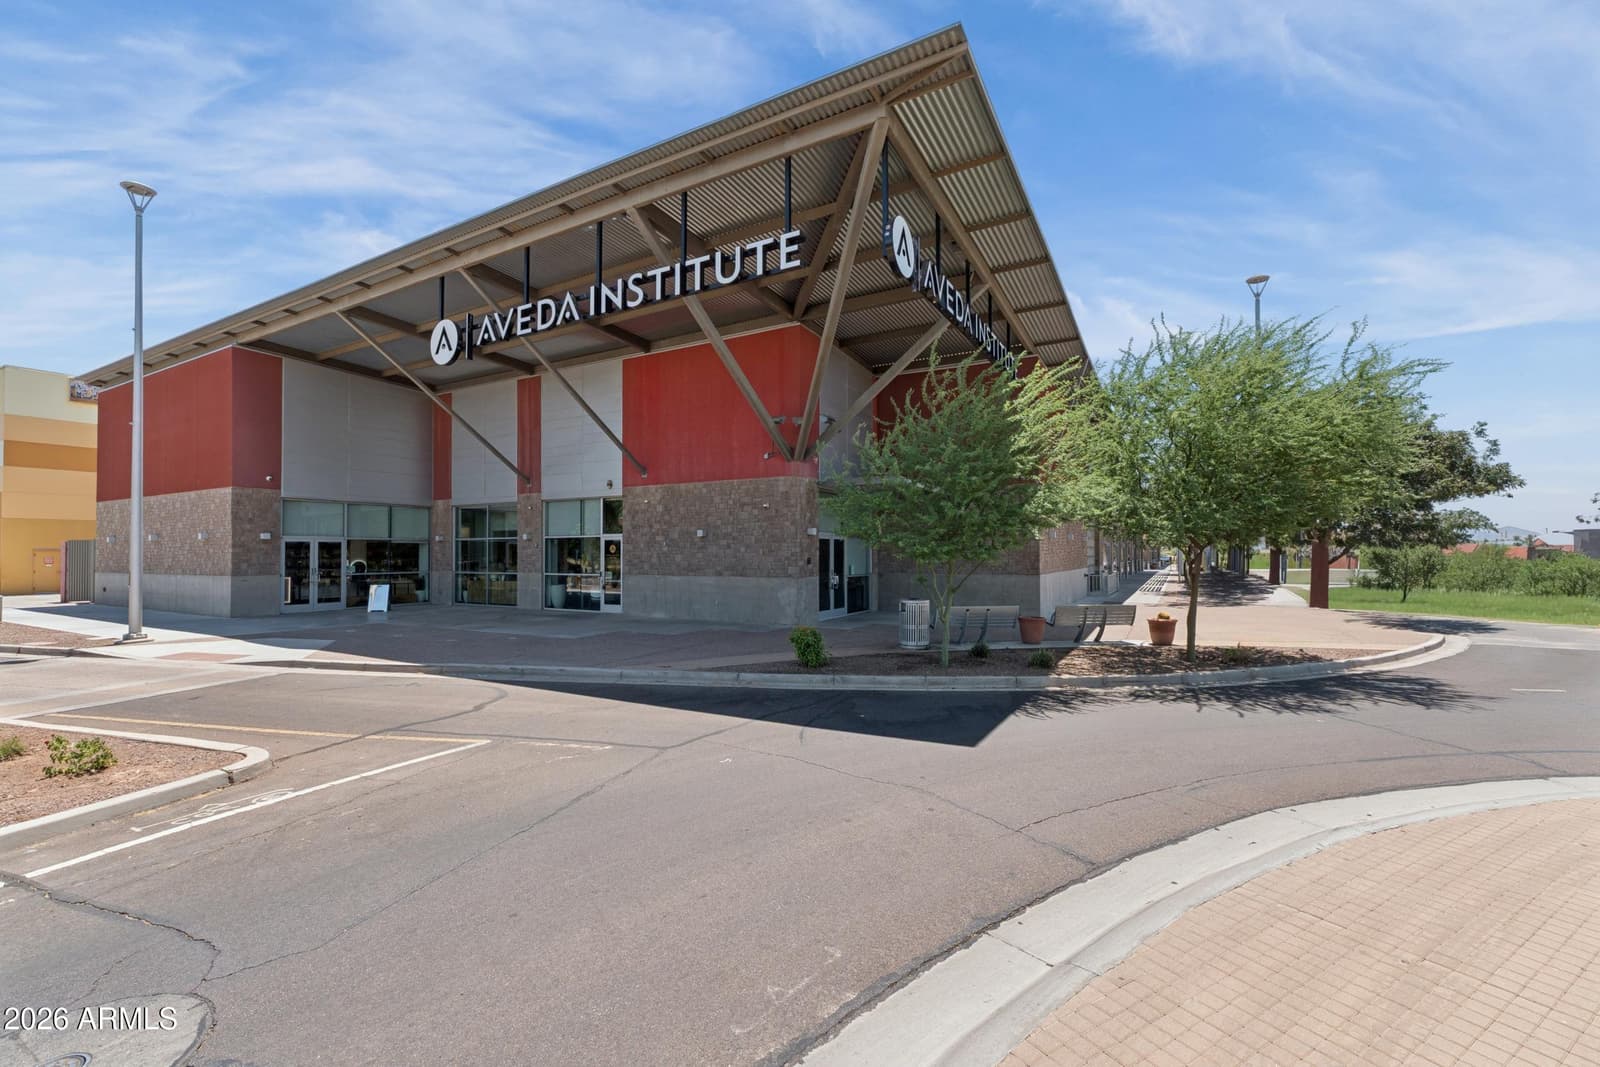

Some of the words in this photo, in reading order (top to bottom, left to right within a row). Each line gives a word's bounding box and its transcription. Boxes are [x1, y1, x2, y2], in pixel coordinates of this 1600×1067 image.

[476, 291, 580, 346] AVEDA
[589, 230, 801, 316] INSTITUTE
[924, 261, 973, 334] AVEDA
